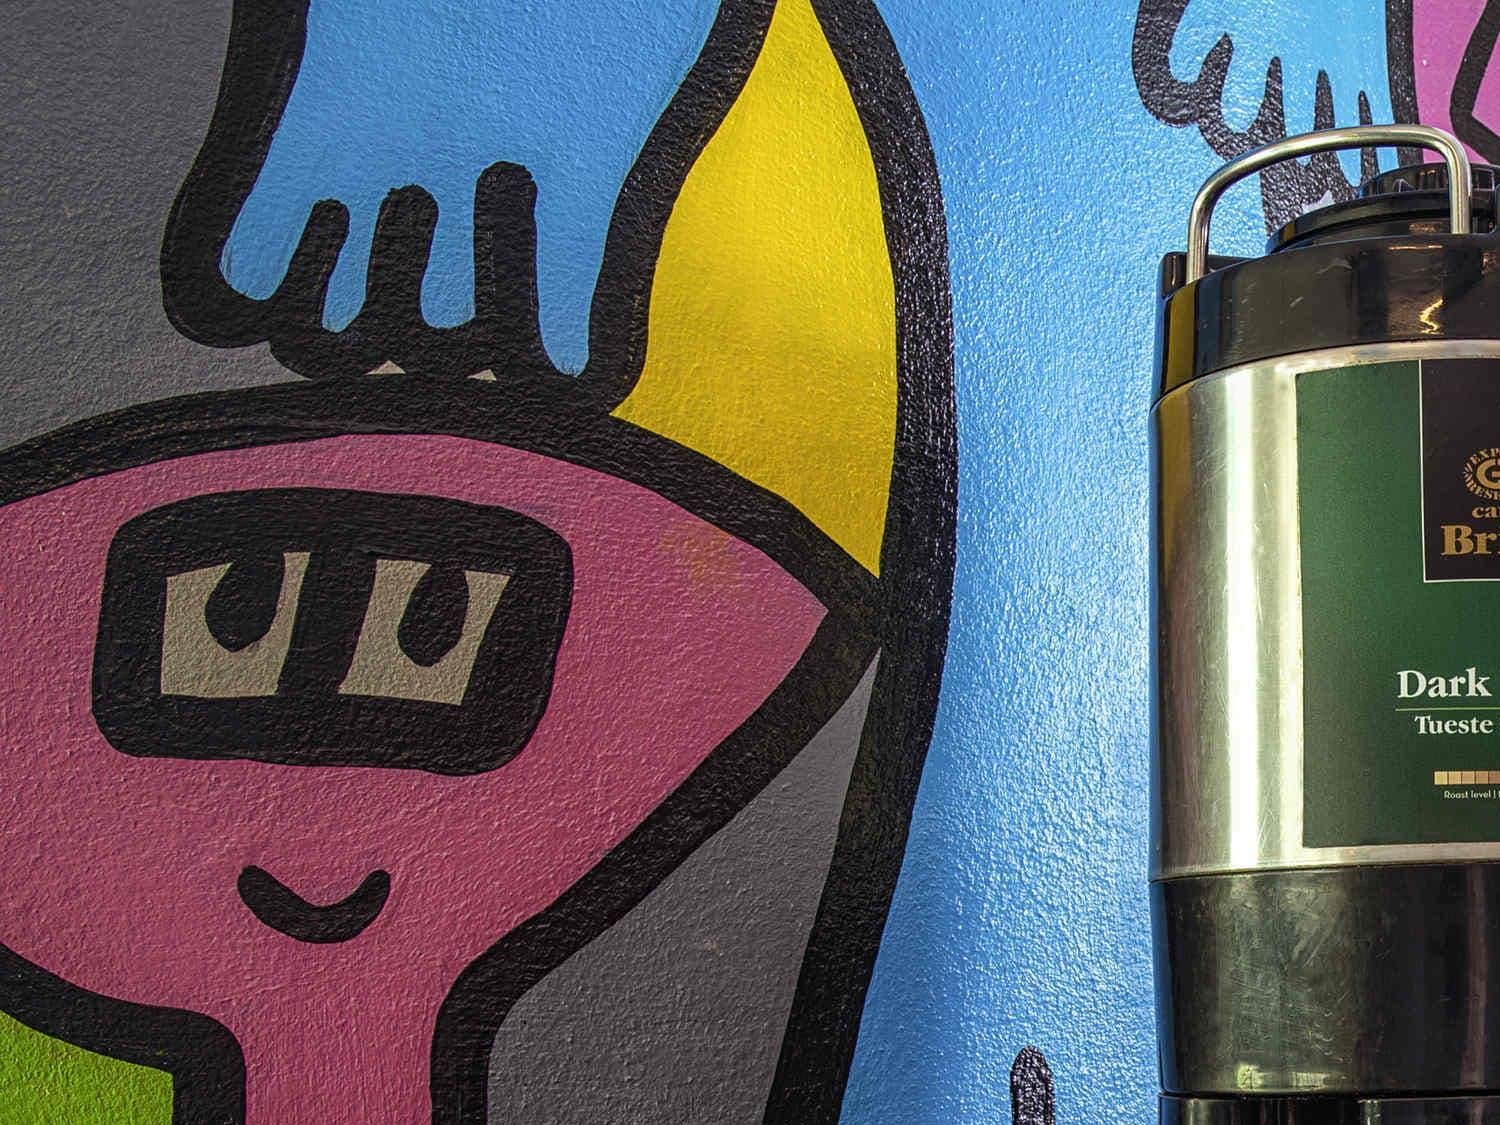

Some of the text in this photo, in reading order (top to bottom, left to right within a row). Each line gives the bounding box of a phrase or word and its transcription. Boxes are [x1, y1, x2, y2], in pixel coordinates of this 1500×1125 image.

[1397, 666, 1493, 699] Dark
[1414, 713, 1494, 735] Tueste
[1443, 790, 1469, 799] Roast
[1470, 789, 1492, 799] level
